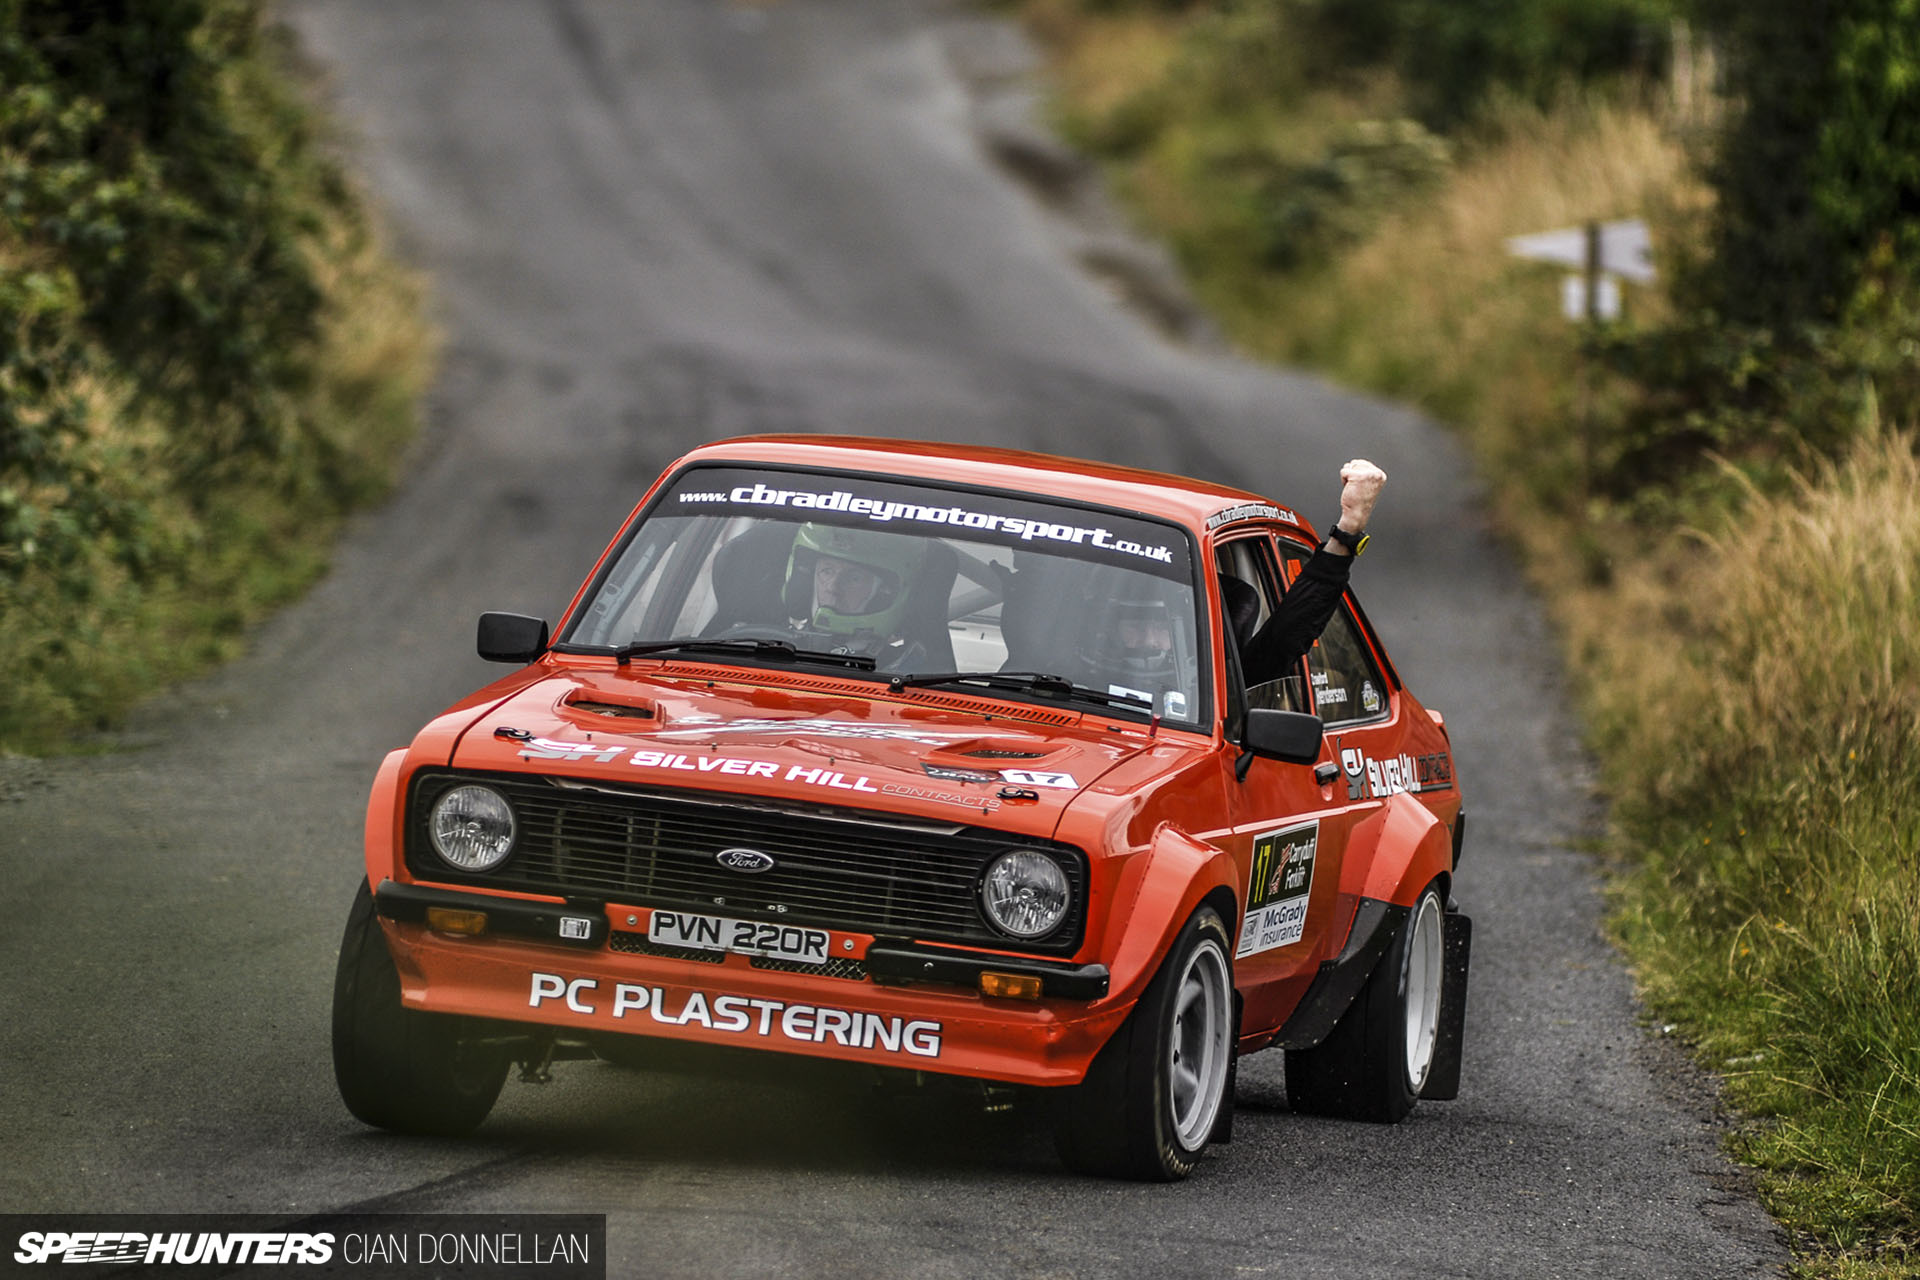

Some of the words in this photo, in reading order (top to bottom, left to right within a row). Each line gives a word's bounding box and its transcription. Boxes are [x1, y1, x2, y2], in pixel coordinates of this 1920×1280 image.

[679, 484, 1173, 563] www.cbradleymotorsport.co.uk
[629, 751, 780, 778] SILVER
[784, 766, 878, 793] HILL
[881, 782, 1002, 809] CONTRACTS
[1012, 772, 1064, 784] 17
[728, 852, 761, 867] Ford
[1253, 844, 1271, 903] 17
[654, 911, 721, 945] PVN
[732, 922, 828, 958] 220R
[1259, 923, 1302, 946] insurance
[1263, 900, 1306, 929] McGrady
[528, 972, 597, 1014] PC
[612, 983, 942, 1058] PLASTERING
